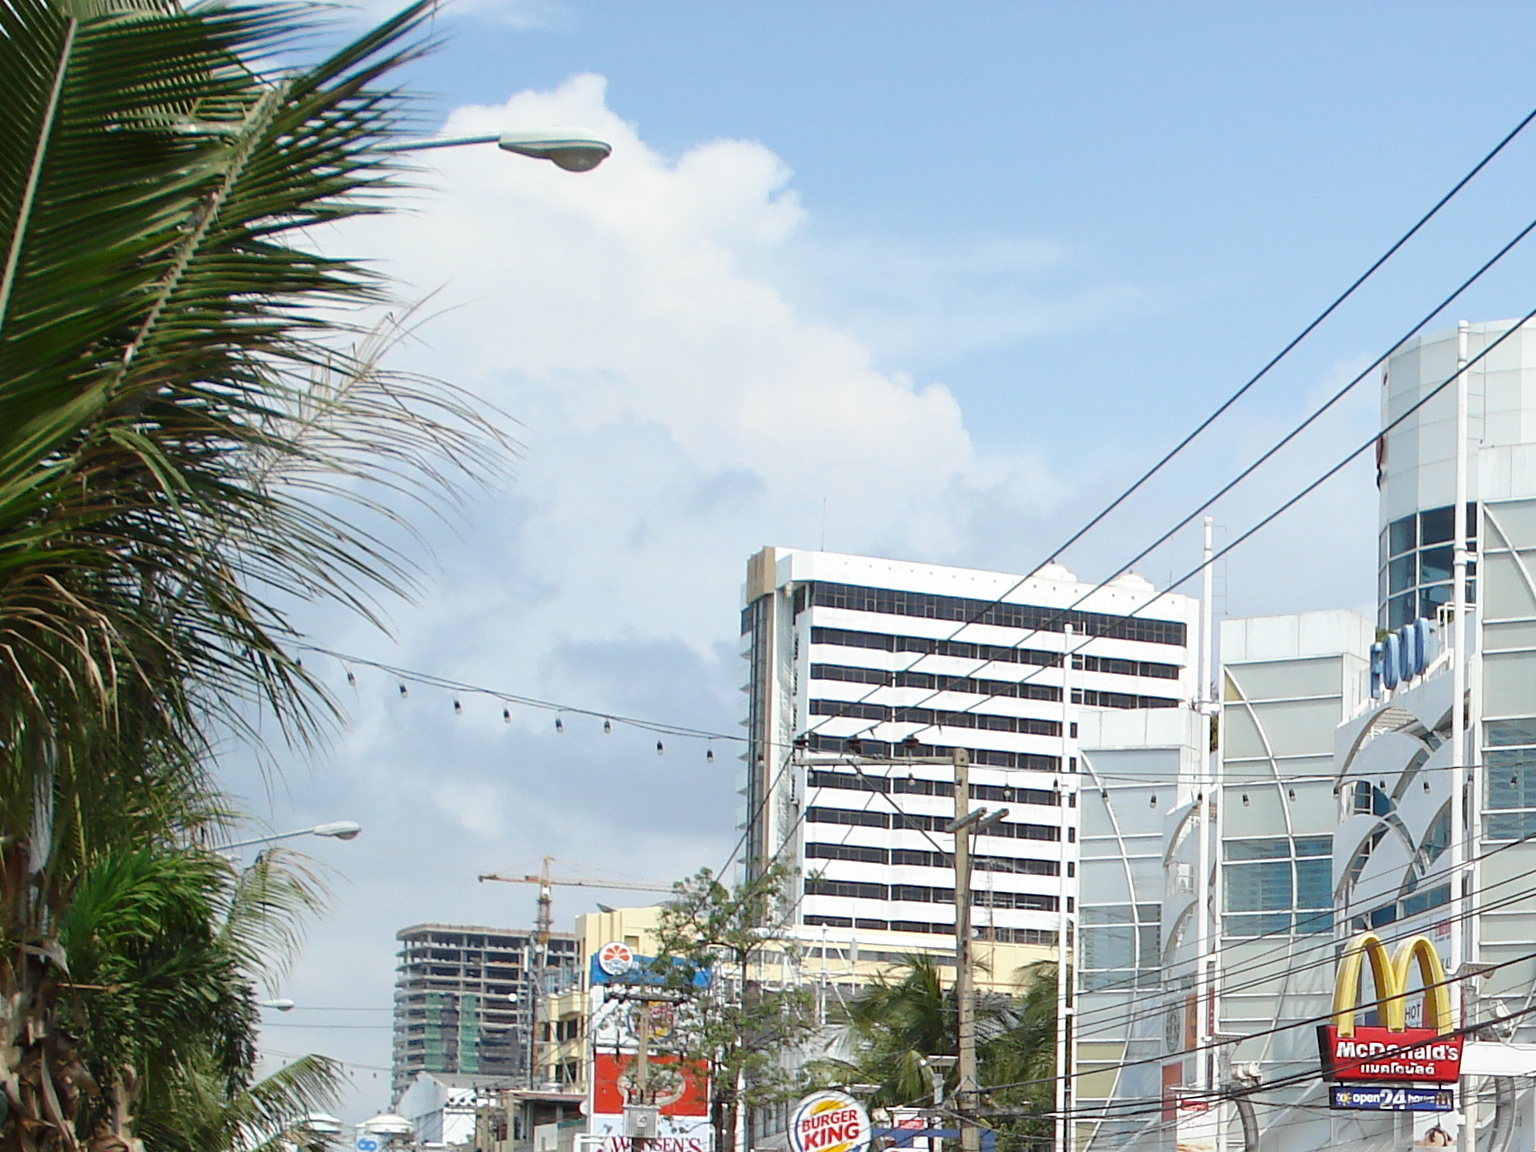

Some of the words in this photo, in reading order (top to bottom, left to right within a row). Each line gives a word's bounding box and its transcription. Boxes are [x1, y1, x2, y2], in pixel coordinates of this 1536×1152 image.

[1369, 616, 1430, 700] FOOD
[1405, 1004, 1421, 1020] HOT
[1352, 1092, 1381, 1105] open
[1379, 1088, 1406, 1110] 24
[801, 1109, 858, 1133] BURGER
[803, 1122, 860, 1152] KING
